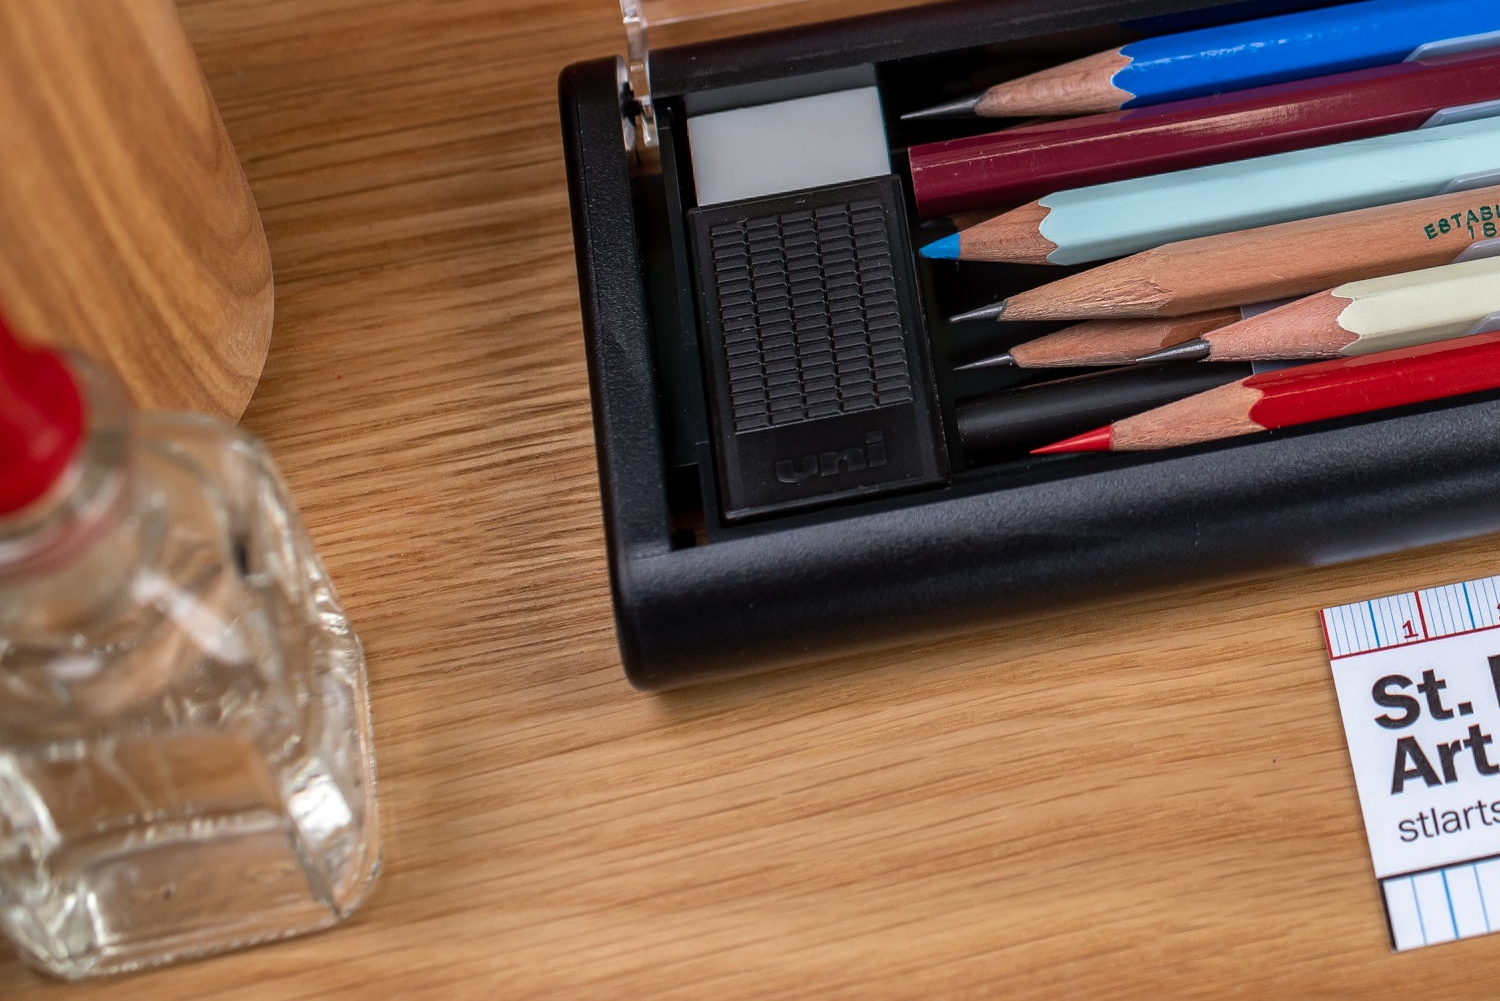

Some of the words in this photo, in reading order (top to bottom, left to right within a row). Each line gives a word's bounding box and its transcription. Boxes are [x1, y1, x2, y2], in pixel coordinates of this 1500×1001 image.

[774, 430, 888, 484] uni
[1402, 621, 1419, 639] 1
[1371, 669, 1474, 730] St.
[1389, 724, 1500, 796] Art
